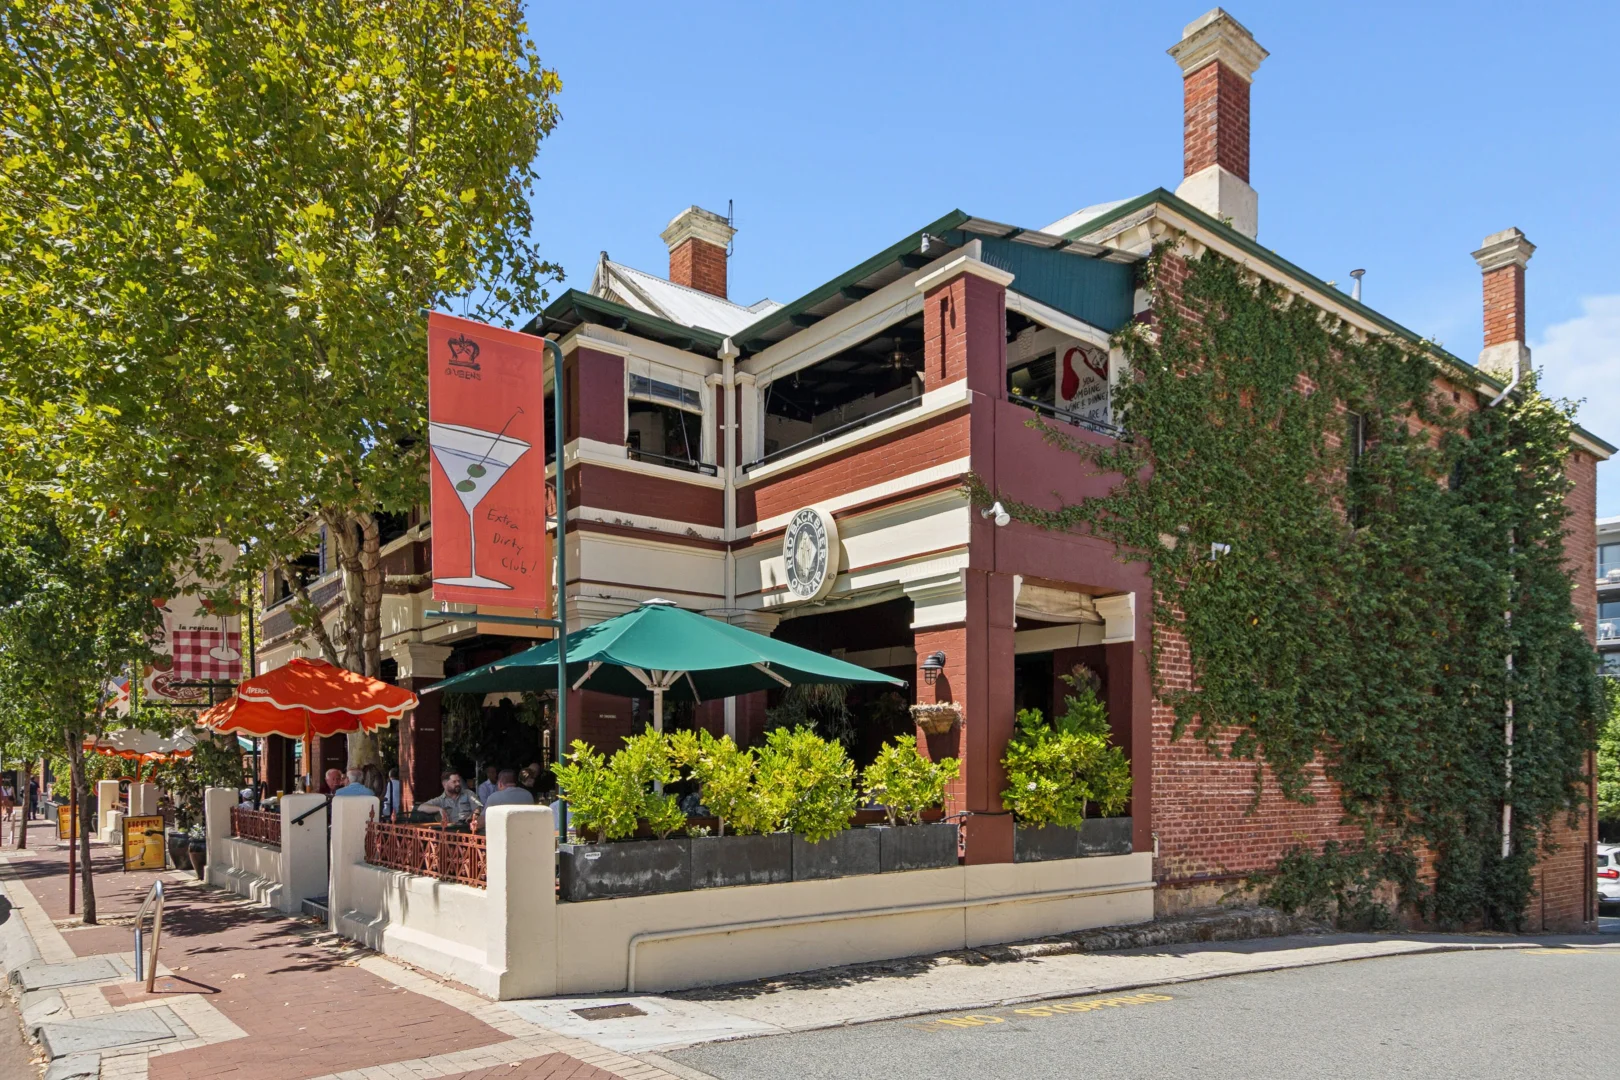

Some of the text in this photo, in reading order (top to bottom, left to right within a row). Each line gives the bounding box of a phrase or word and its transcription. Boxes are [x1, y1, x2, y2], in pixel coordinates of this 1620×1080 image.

[445, 367, 482, 381] QUEENS
[1082, 376, 1095, 387] YOU
[1070, 383, 1101, 402] OMBINE
[1065, 400, 1080, 412] WINE
[1088, 408, 1100, 419] ARE
[487, 508, 520, 530] Extra
[492, 532, 524, 556] Dirty
[814, 517, 826, 562] BEER
[791, 570, 822, 594] ON TAP
[245, 686, 270, 695] APEROL
[937, 1014, 1005, 1028] NO
[1013, 993, 1174, 1017] STOPPING
